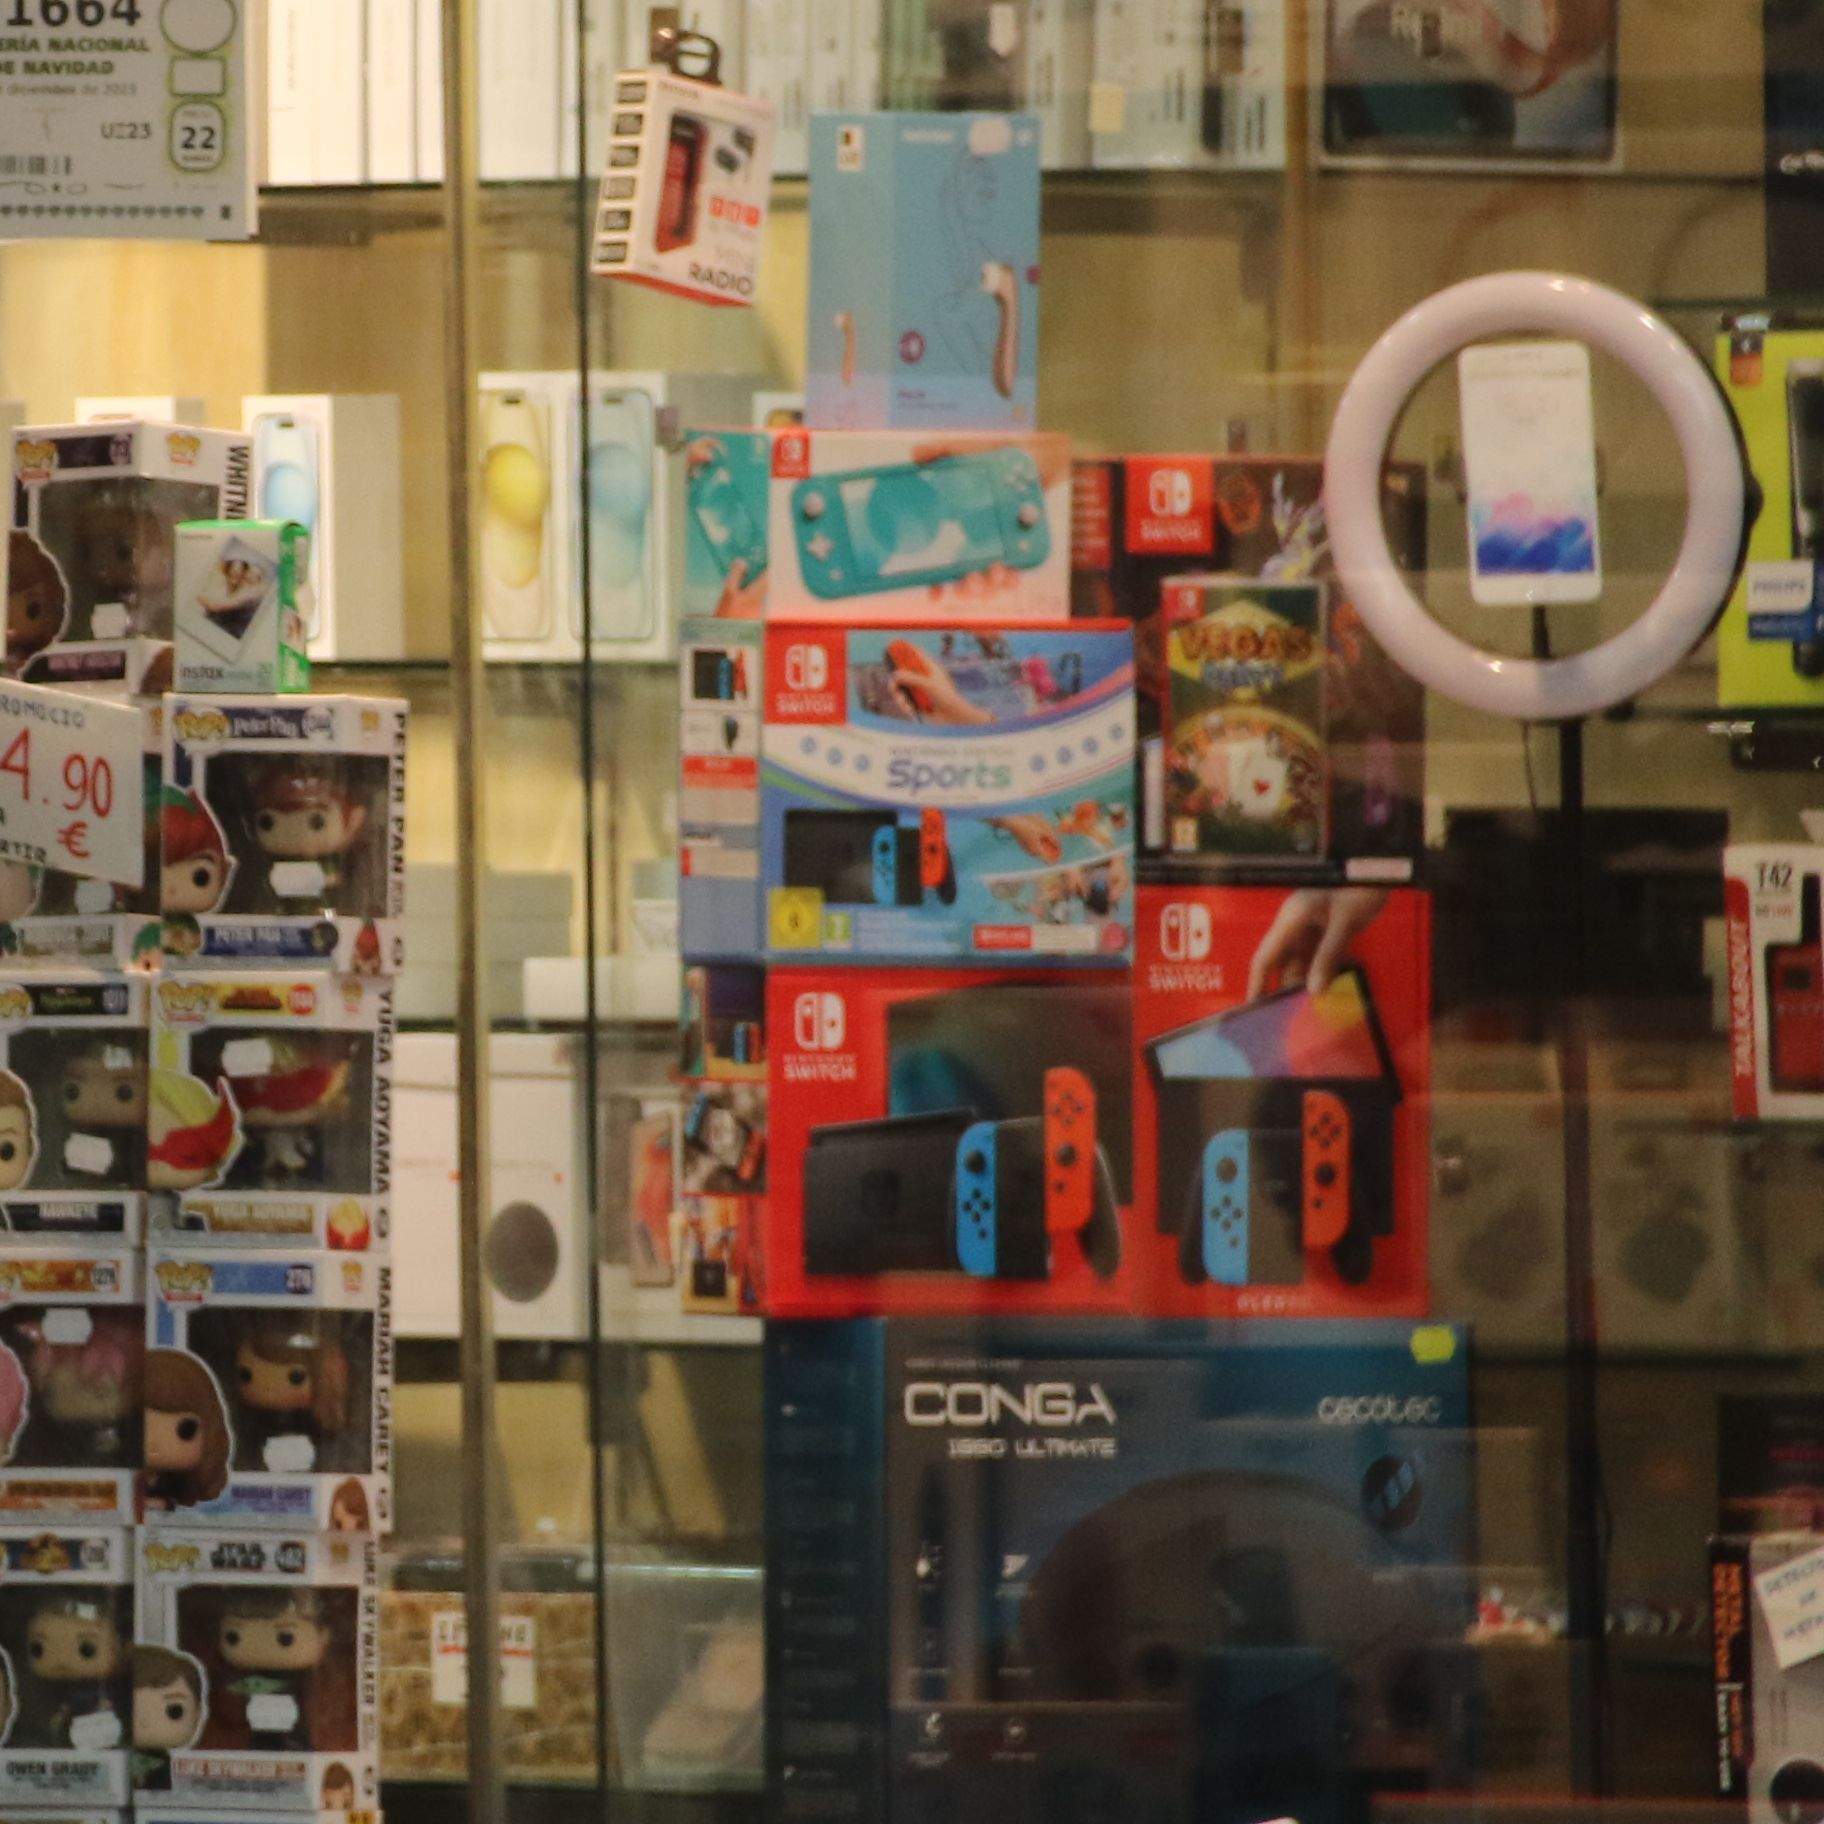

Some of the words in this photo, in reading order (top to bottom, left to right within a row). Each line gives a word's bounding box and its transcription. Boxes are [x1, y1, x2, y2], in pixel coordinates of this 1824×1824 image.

[47, 36, 150, 52] NACIONAL
[22, 59, 115, 75] NAVIDAD
[180, 126, 214, 150] 22
[689, 262, 754, 295] RADIO
[226, 445, 250, 521] WHITN
[393, 712, 406, 804] PETER
[886, 759, 1013, 792] Sports
[55, 820, 92, 858] €
[393, 816, 406, 874] PAN
[1756, 861, 1792, 889] T42
[377, 990, 392, 1064] YUGA
[376, 1076, 392, 1195] AOYAMA
[377, 1266, 392, 1375] MARIAH
[903, 1381, 1119, 1426] CONGA
[377, 1386, 392, 1474] CAREY
